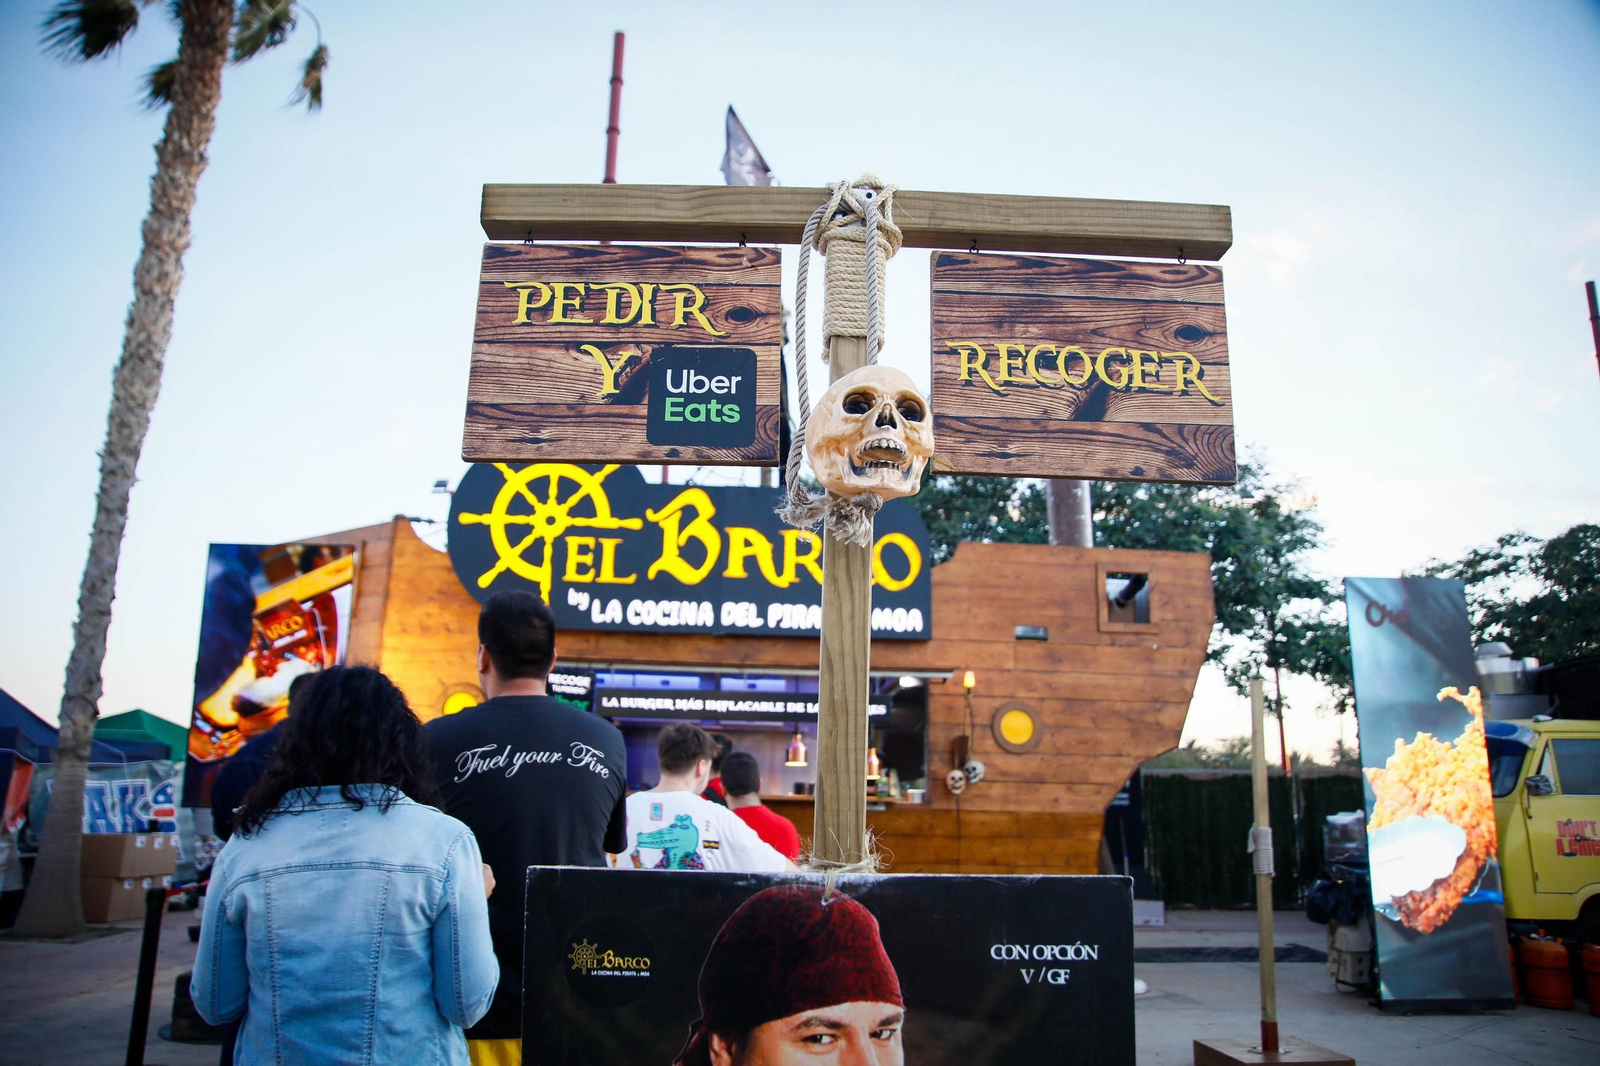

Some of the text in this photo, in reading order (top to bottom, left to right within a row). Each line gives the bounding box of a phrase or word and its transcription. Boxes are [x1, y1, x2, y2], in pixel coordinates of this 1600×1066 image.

[504, 282, 726, 336] PEDIR
[580, 344, 634, 396] Y
[666, 369, 741, 394] Uber
[946, 341, 1221, 401] RECOGER
[665, 397, 741, 423] Eats
[562, 488, 922, 592] EL BARO
[567, 587, 590, 611] by
[591, 598, 623, 624] LA
[626, 599, 714, 627] COCINA
[721, 601, 764, 628] DEL
[872, 607, 923, 632] MOA
[602, 697, 619, 708] LA
[620, 697, 675, 711] BURGER
[786, 702, 805, 713] DE
[454, 741, 609, 783] Fuel your Fire
[587, 949, 651, 969] EL BARCO
[990, 940, 1099, 960] CON OPCIÓN
[1020, 968, 1035, 984] V
